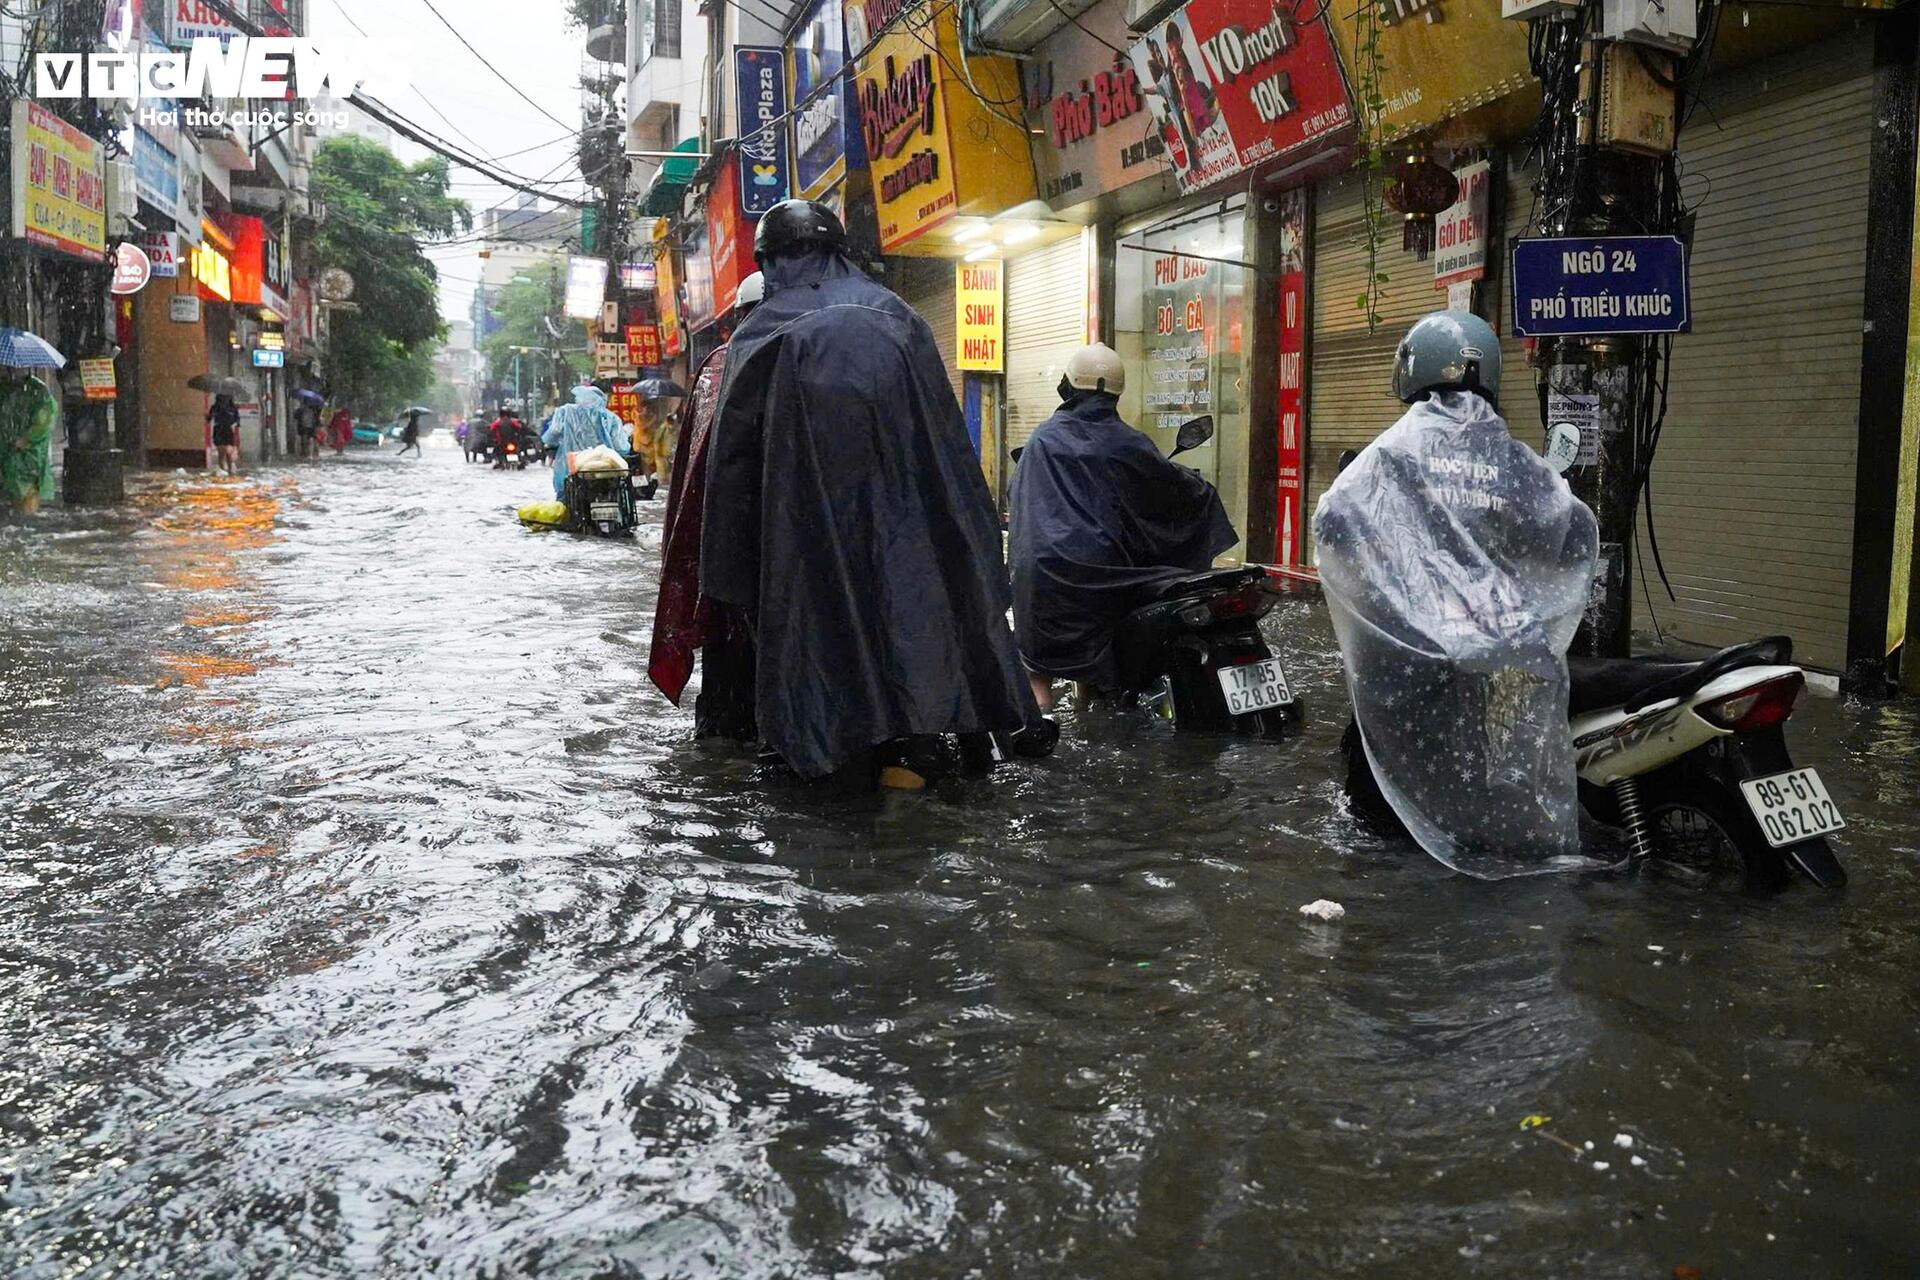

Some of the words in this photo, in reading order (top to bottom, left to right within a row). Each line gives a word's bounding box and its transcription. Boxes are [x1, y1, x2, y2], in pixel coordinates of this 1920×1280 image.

[757, 67, 777, 162] KidsPlaza
[861, 52, 937, 162] Bakery
[1250, 73, 1290, 124] 10K
[962, 265, 997, 291] BÁNH
[1562, 245, 1606, 275] NGÕ
[1611, 250, 1637, 273] 24
[964, 304, 995, 326] SINH
[1285, 291, 1297, 329] VO
[1531, 286, 1567, 320] PHỐ
[1571, 288, 1620, 319] TRIỀU
[1625, 287, 1673, 317] KHÚC
[962, 334, 997, 366] NHẬT
[1280, 353, 1301, 390] MART
[1283, 413, 1295, 450] 10K
[1230, 683, 1289, 711] 628.86
[1755, 771, 1818, 809] 89-G1
[1764, 799, 1842, 841] 062.02
